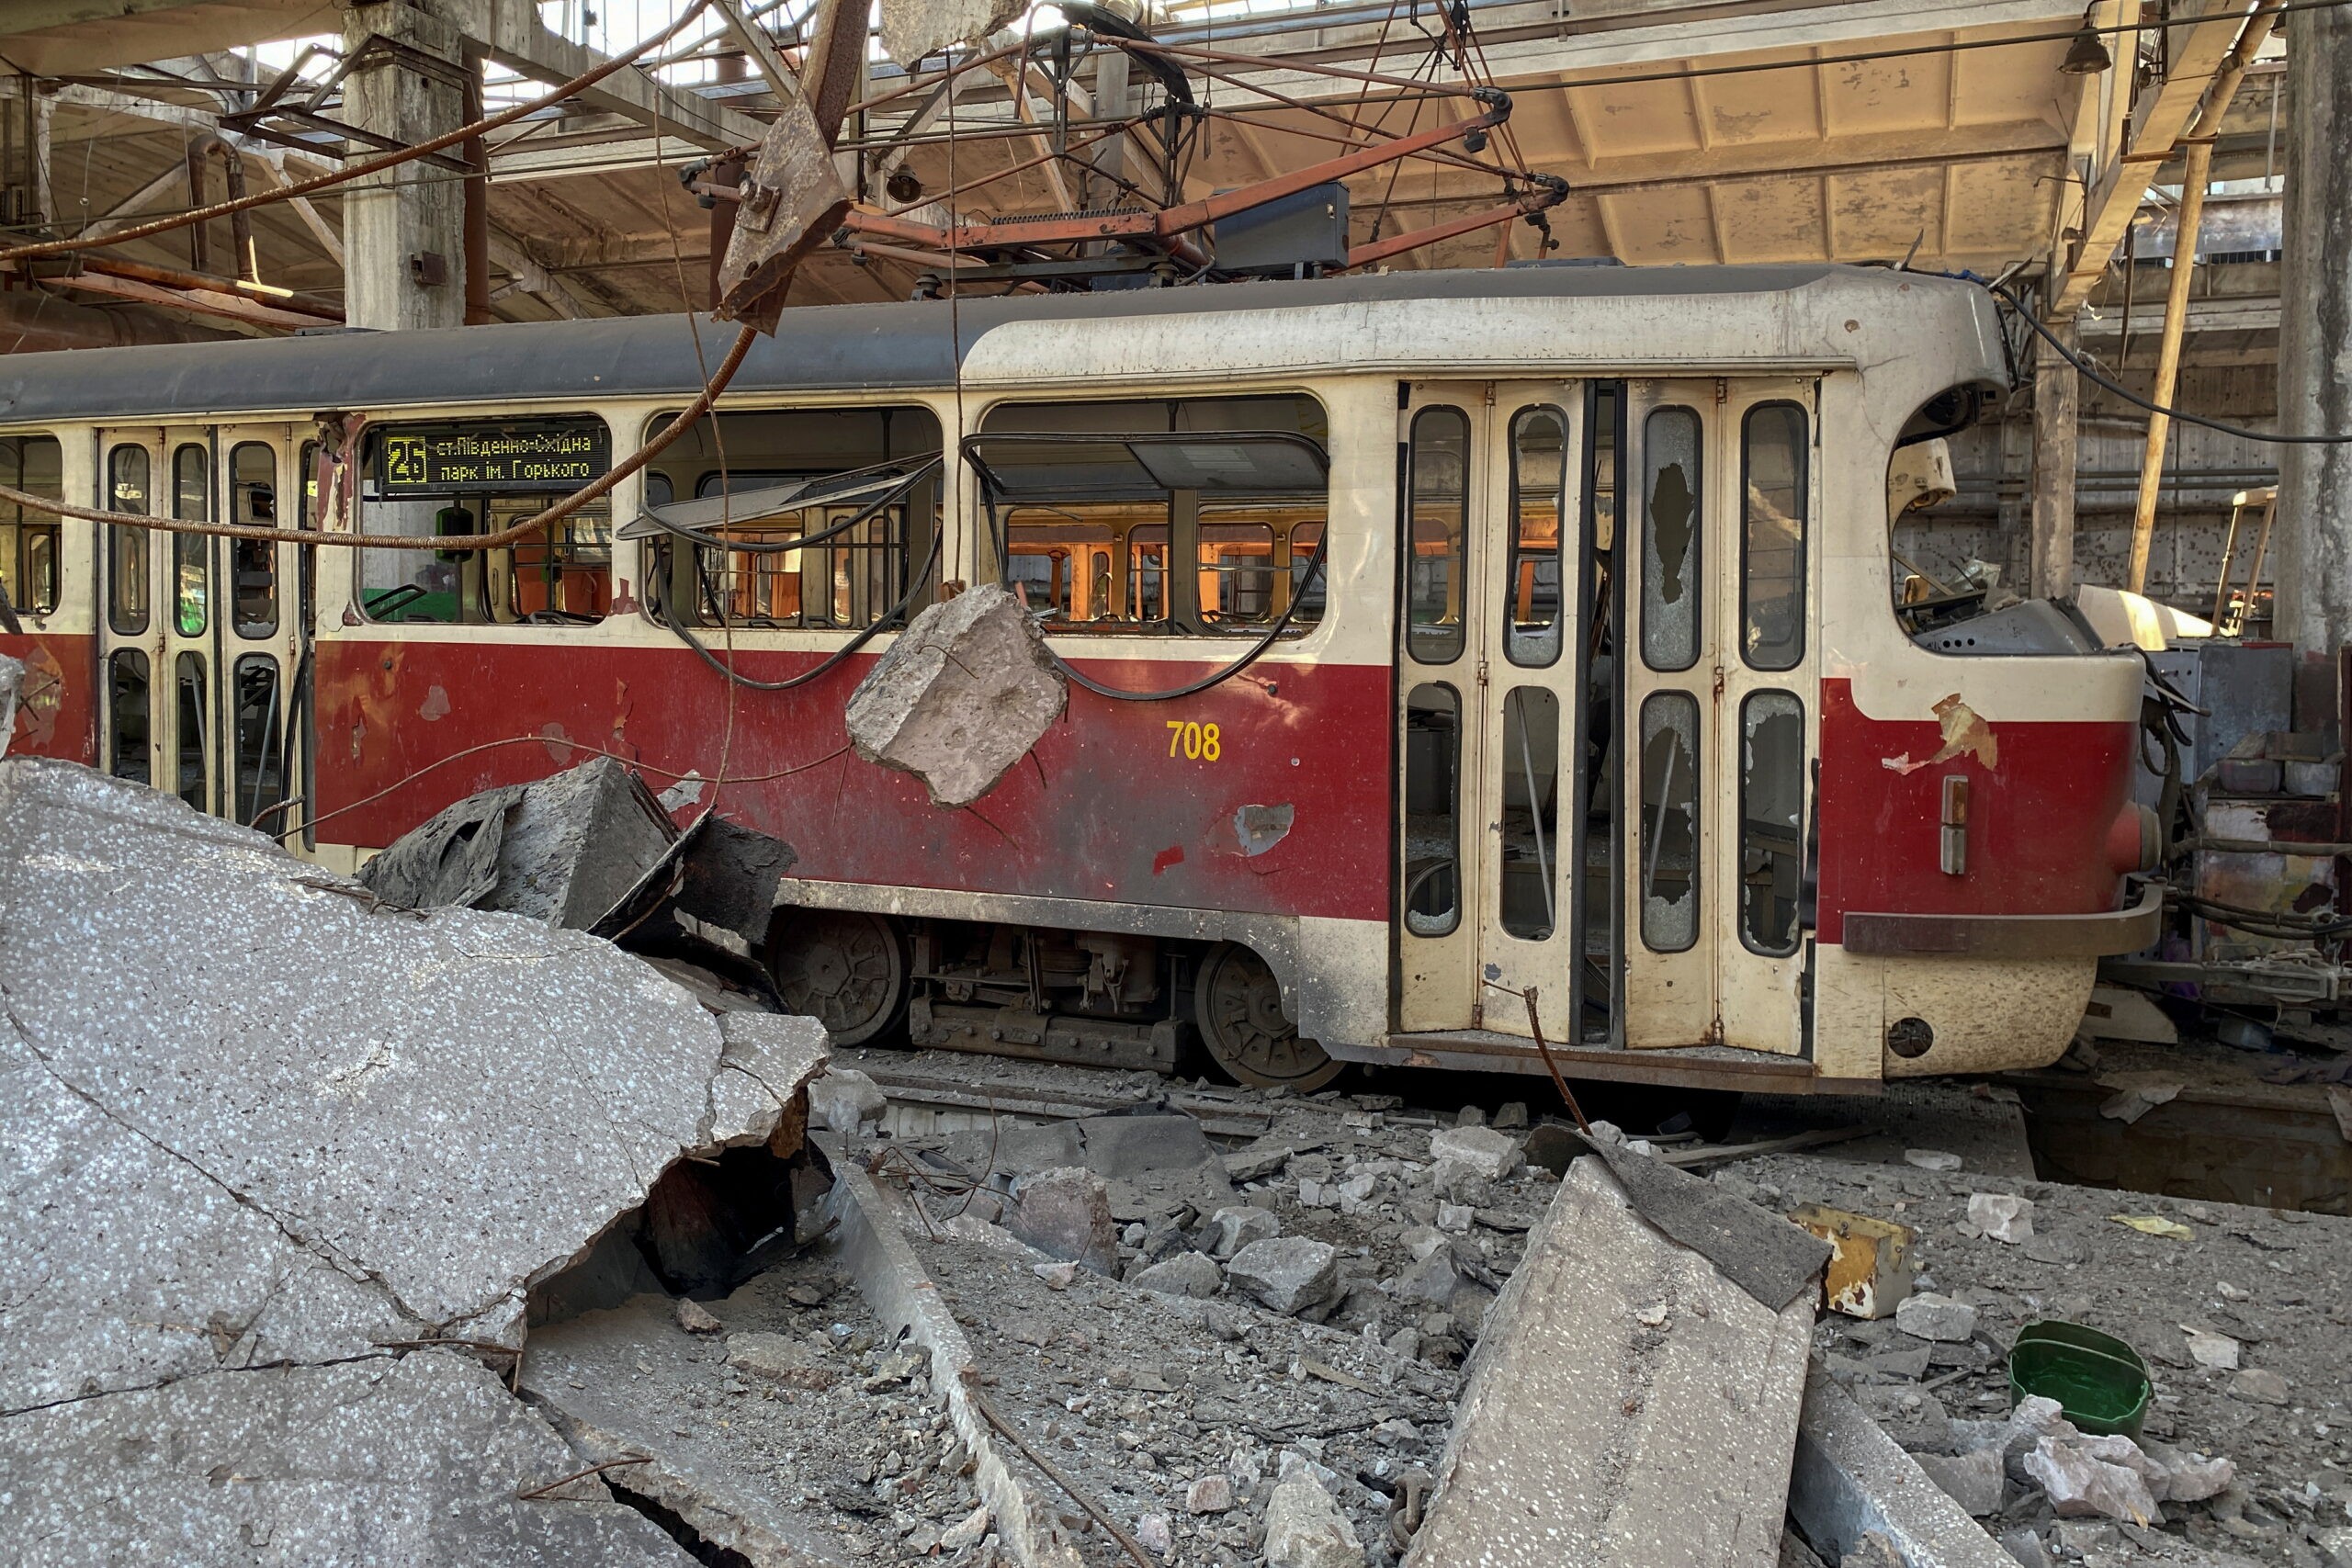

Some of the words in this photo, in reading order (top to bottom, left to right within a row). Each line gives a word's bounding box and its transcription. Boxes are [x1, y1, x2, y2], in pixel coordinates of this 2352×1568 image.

[389, 440, 426, 482] 26
[441, 466, 479, 482] парк
[486, 460, 505, 479] ім.
[513, 459, 589, 479] Горького
[1167, 721, 1221, 761] 708
